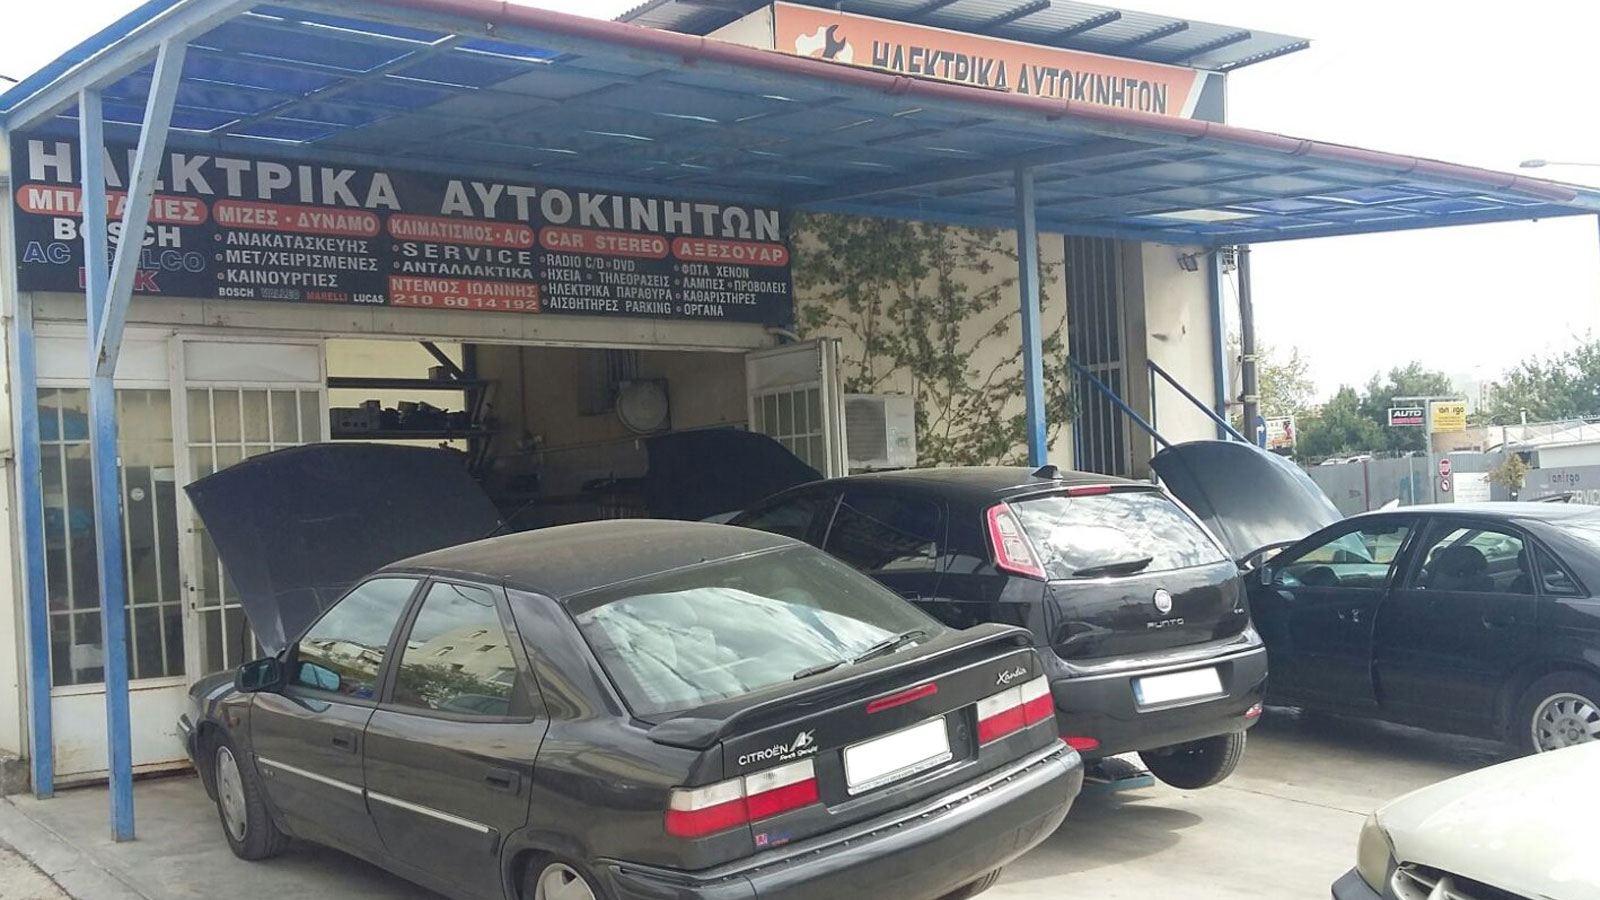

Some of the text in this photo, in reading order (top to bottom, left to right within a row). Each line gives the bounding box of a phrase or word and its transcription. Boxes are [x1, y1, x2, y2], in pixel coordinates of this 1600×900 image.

[872, 40, 1007, 88] ΗΛΕΚΤΡΙΚΑ
[28, 188, 200, 221] ΜΠΑΙΕΣ
[440, 179, 780, 242] ΑΥΤΟΚΙΝΗΤΩΝ
[219, 206, 375, 232] ΜΙΖΕΣ ΔΥΝΑΜΟ
[53, 217, 181, 248] BSCH
[391, 218, 530, 245] ΚΛΙΜΑΤΙΣΜΟΣ A/C
[226, 231, 369, 254] ΑΝΑΚΑΤΑΣΚΕΥΗΣ
[546, 231, 664, 254] CAR STEREO
[680, 242, 783, 262] ΑΞΕΣΟΥΑΡ
[22, 241, 206, 273] AC LCO
[226, 250, 378, 272] ΜΕΤ/ΧΕΙΡΙΣΜΕΝΕΣ
[402, 242, 533, 265] SERVICE
[546, 254, 635, 272] RADIO C/D DVD
[227, 269, 338, 288] ΚΑΙΝΟΥΡΓΙΕΣ
[402, 261, 534, 279] ΑΝΤΑΛΛΑΚΤΙΚΑ
[547, 268, 670, 287] ΗΧΕΙΑ ΤΗΛΕΟΡΑΣΕΙΣ
[681, 263, 710, 276] ΦΩΤΑ
[218, 287, 254, 298] BOSCH
[307, 291, 348, 302] MARELLI
[353, 293, 384, 304] LUCAS
[391, 278, 536, 298] ΝΤΕΜΟΣ ΙΩΑΝΝΗΣ
[548, 282, 673, 301] ΗΛΕΚΤΡΙΚΑ ΠΑΡΑΘΥΡΑ
[683, 277, 787, 294] ΛΑΜΠΕΣ ΠΡΟΒΟΛΕΙΣ
[393, 294, 434, 306] 210
[550, 296, 671, 314] ΑΙΣΘΗΤΗΡΕΣ PARKING
[683, 289, 757, 305] ΚΑΘΑΡΙΣΤΗΡΕΣ
[683, 303, 724, 317] ΟΡΓΑΝΑ
[1147, 618, 1184, 629] PUNTO
[738, 744, 788, 766] CITROËN
